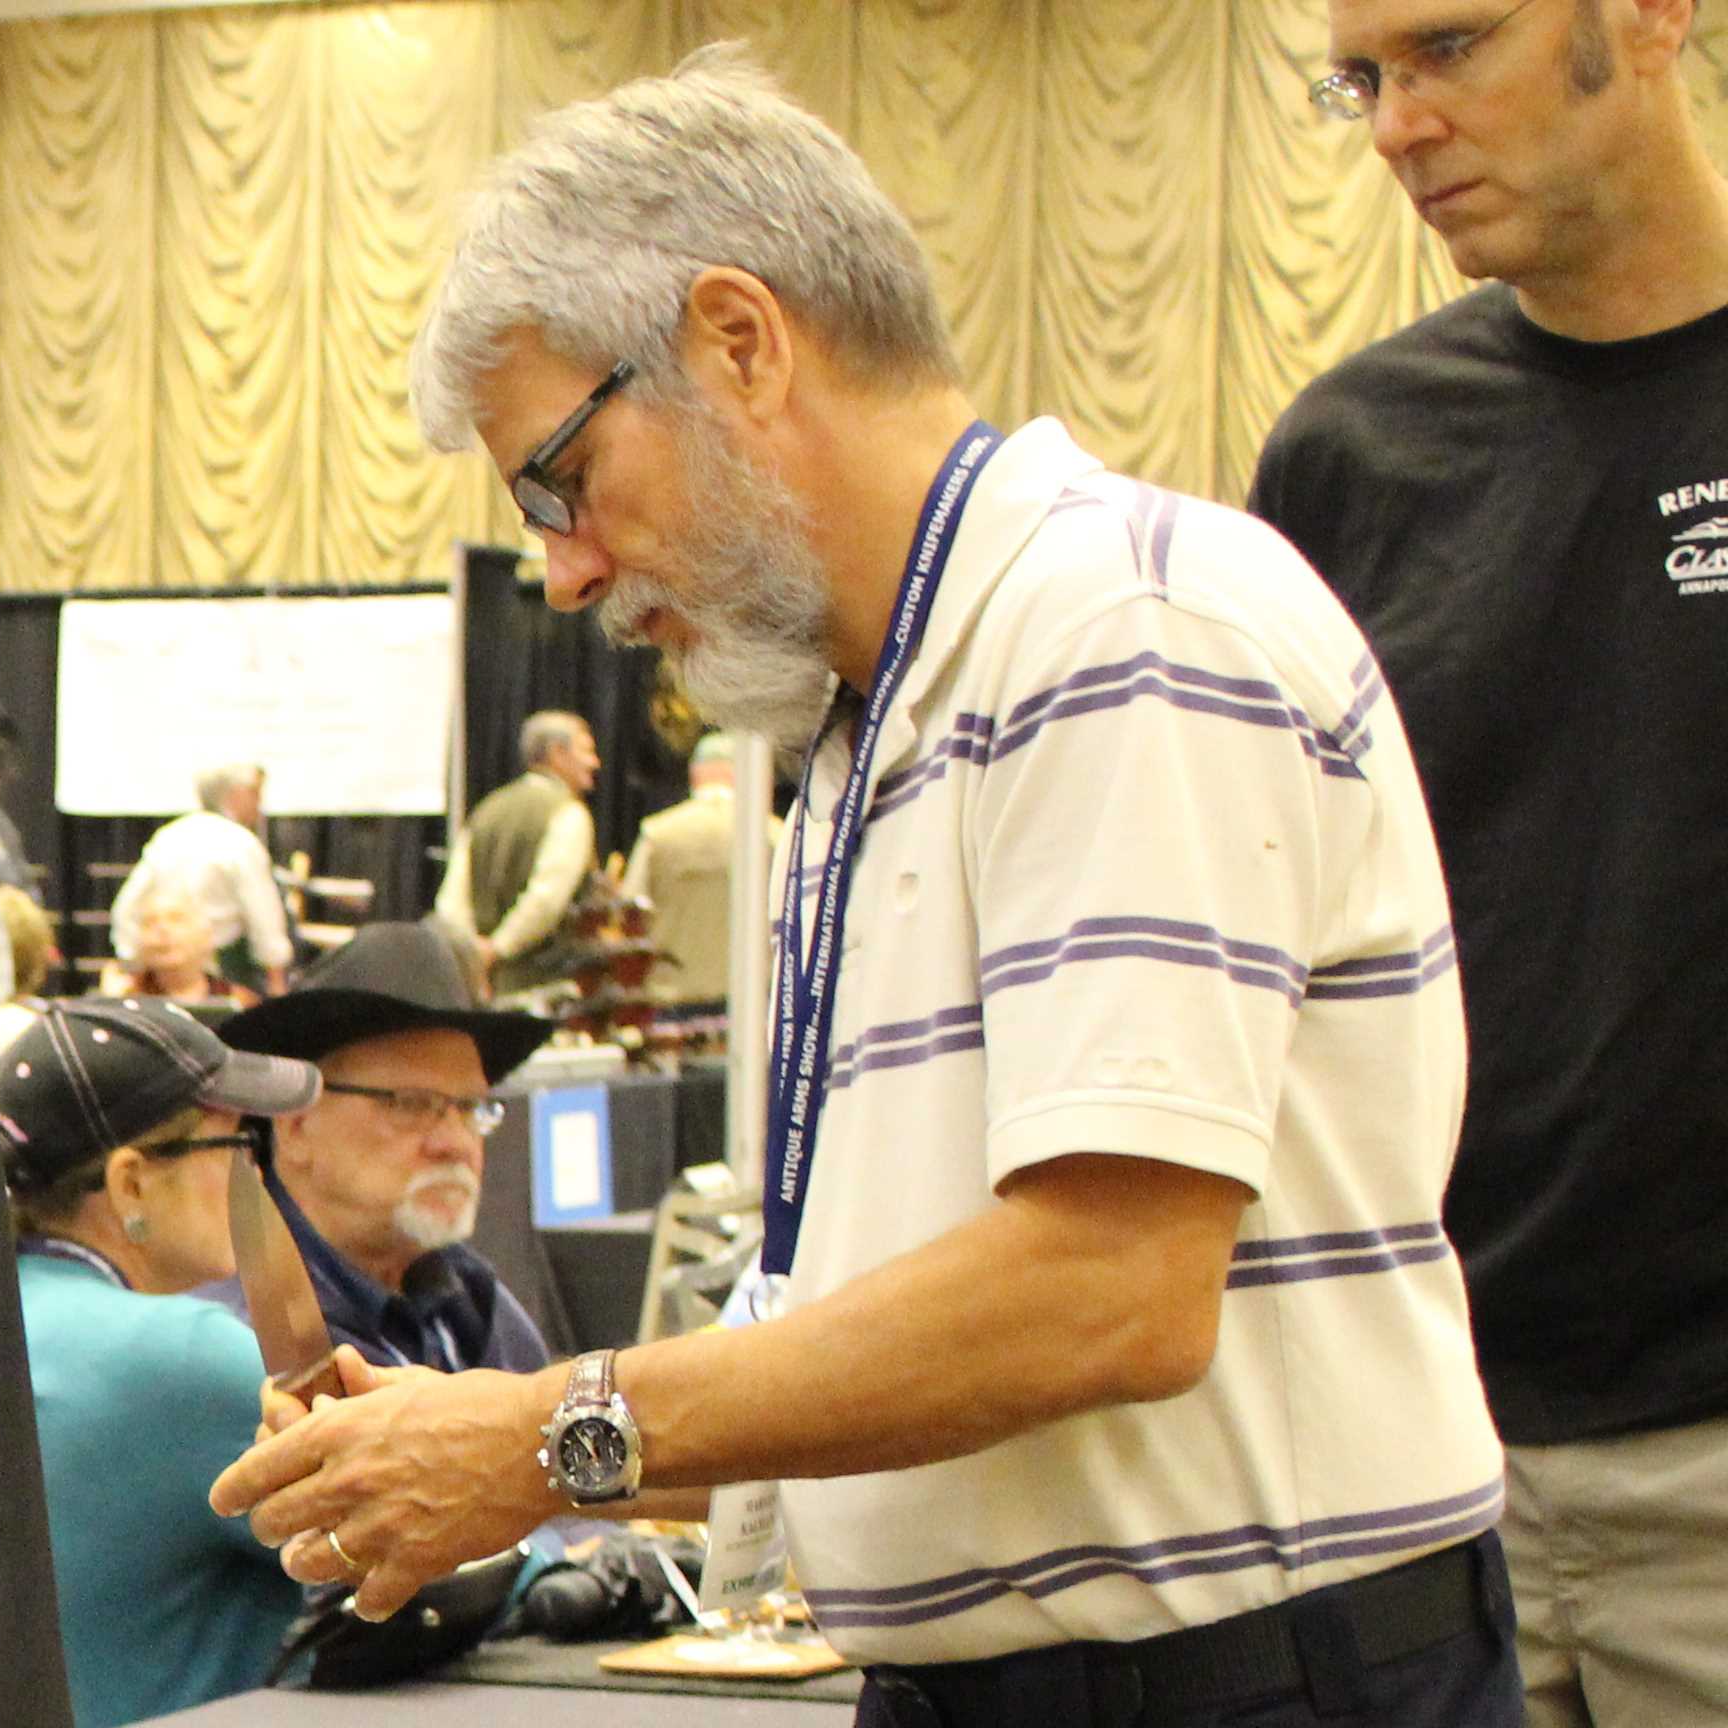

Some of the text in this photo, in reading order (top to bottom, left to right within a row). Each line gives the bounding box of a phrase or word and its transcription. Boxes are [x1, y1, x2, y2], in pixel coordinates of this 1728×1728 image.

[912, 463, 970, 576] KNIFEMAKERS
[836, 772, 862, 862] SPORTING
[791, 1077, 811, 1127] ARMS
[780, 1127, 803, 1205] ANTIQUE
